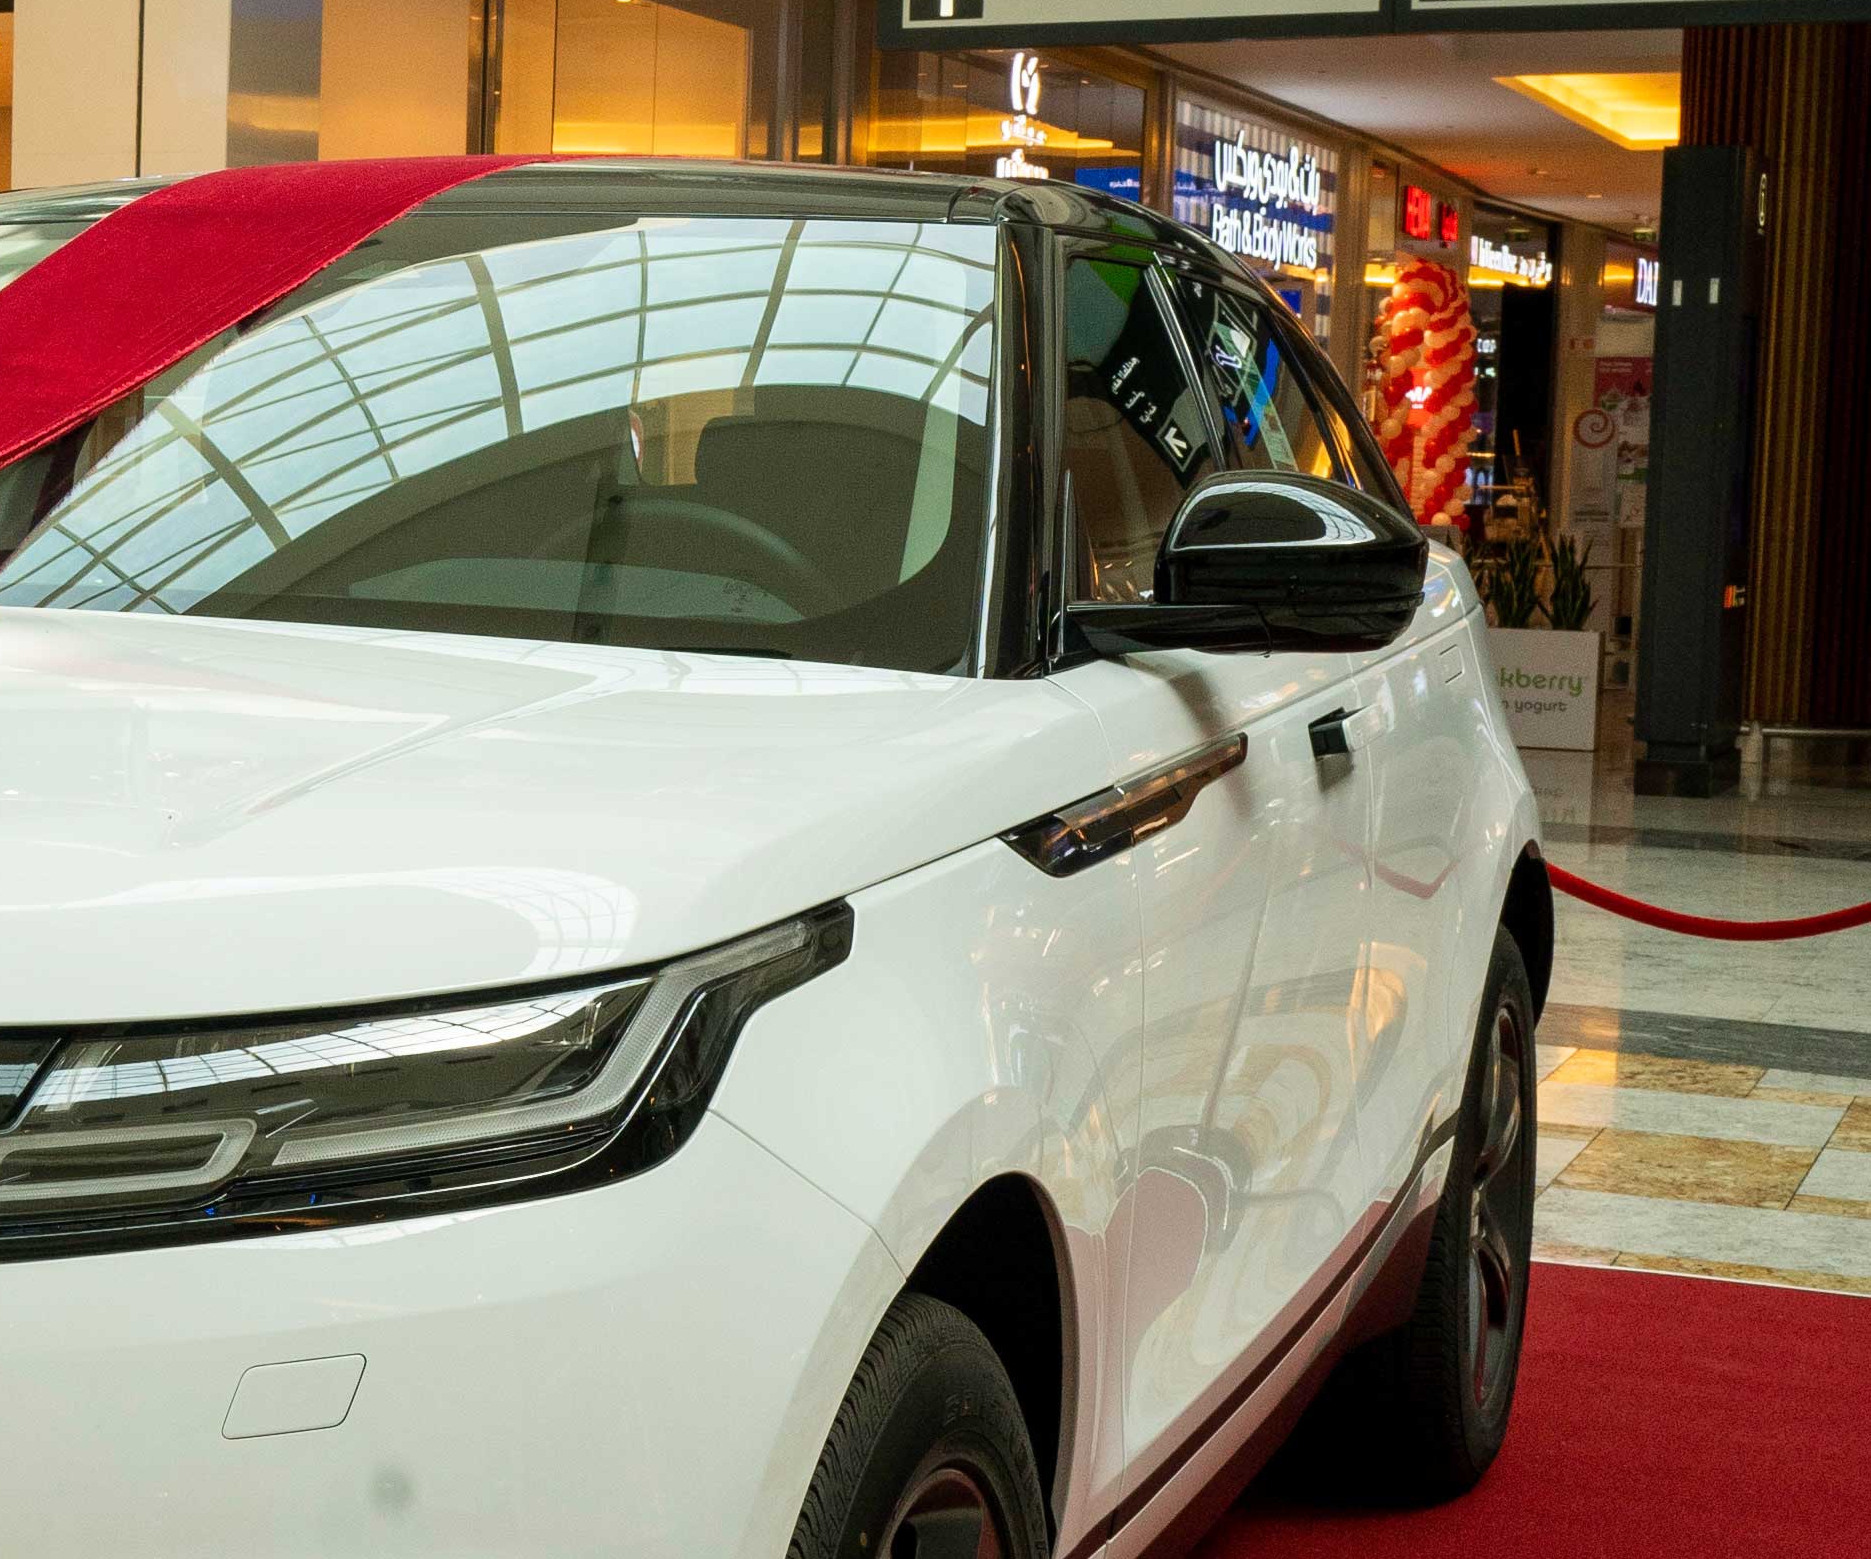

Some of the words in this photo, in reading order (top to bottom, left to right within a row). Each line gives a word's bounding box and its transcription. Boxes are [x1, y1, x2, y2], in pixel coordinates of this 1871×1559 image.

[1212, 203, 1242, 254] Bath
[1252, 213, 1282, 272] Body
[1281, 220, 1318, 270] Works
[1499, 666, 1583, 698] kberry
[1514, 699, 1568, 714] yogurt
